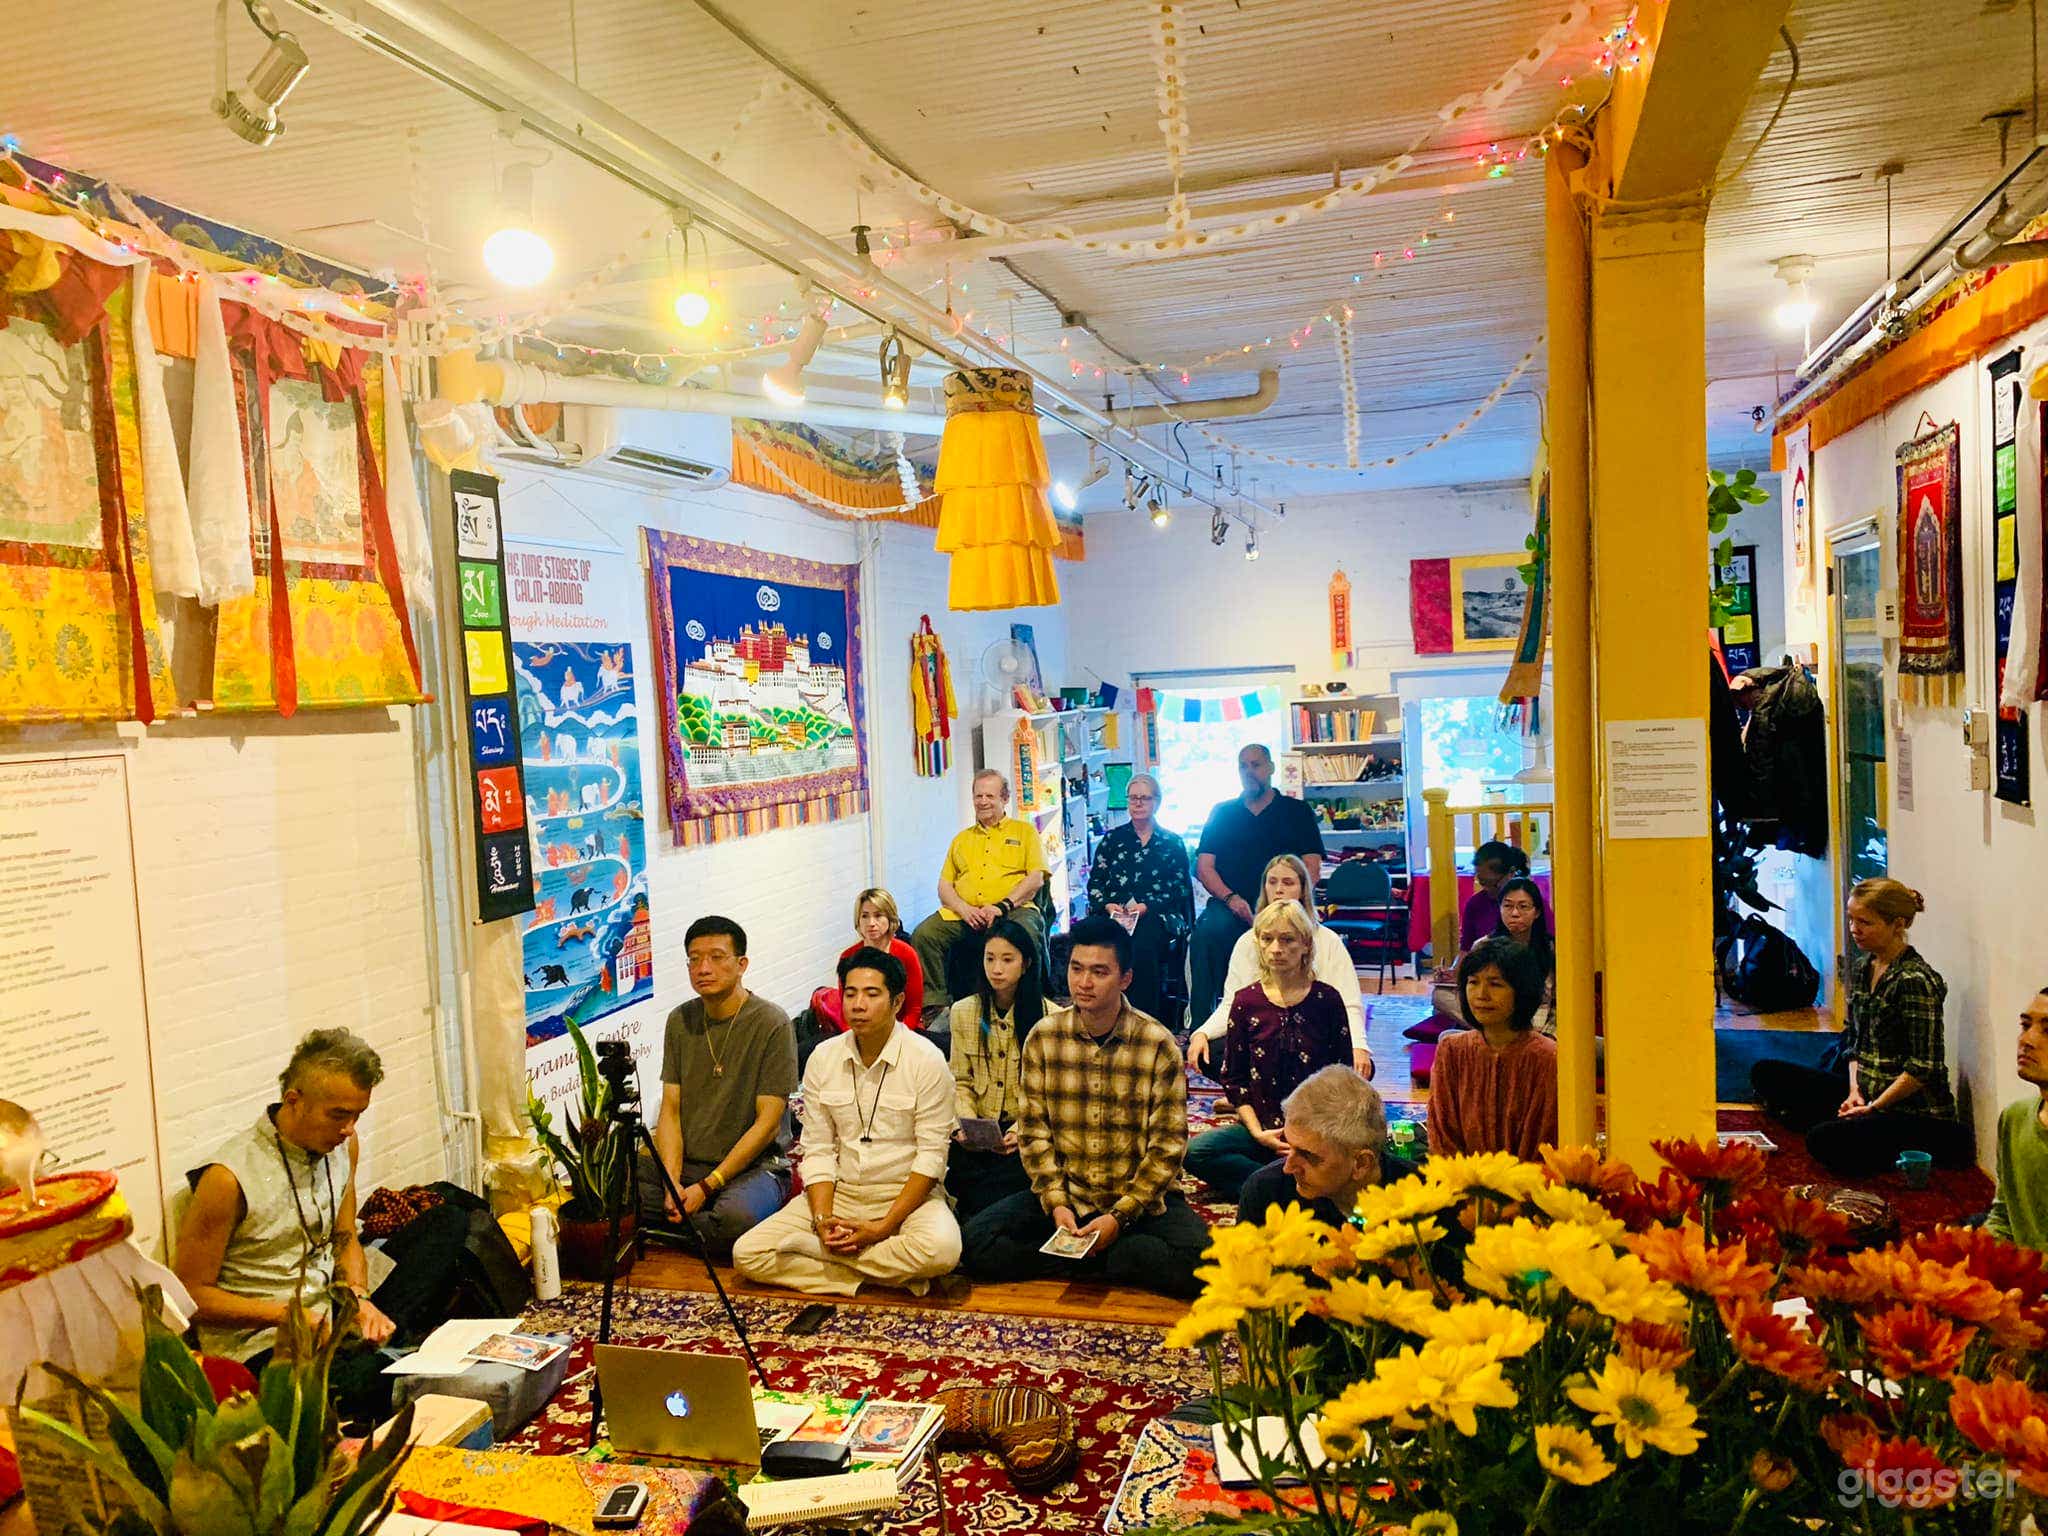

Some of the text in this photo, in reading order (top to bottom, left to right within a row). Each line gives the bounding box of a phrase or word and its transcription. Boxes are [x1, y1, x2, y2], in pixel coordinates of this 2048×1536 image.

[506, 552, 591, 582] HE NINE STAGES OF
[514, 578, 584, 605] CALM-ABIDING
[510, 611, 609, 632] ough Meditation
